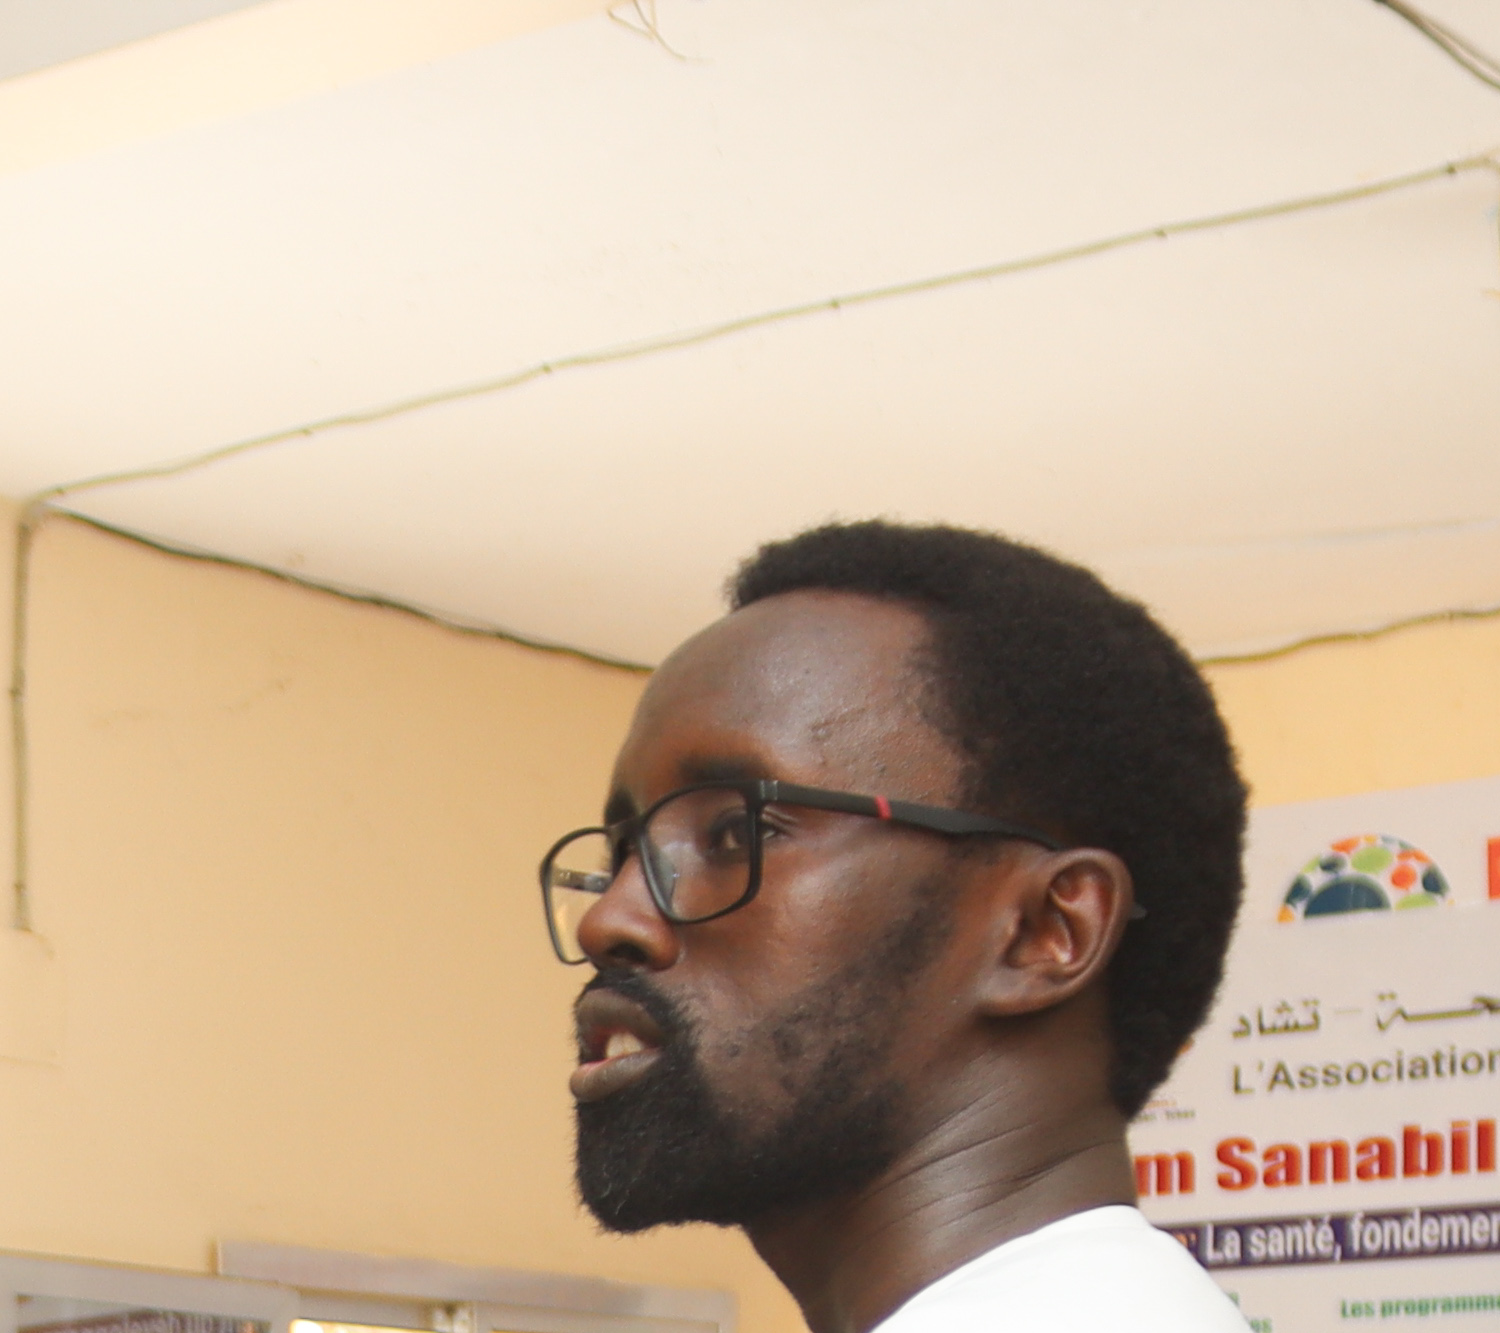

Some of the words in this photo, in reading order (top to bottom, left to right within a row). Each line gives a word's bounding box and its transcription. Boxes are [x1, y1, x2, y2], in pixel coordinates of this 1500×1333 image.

[1232, 1000, 1321, 1038] تشاد
[1214, 1116, 1498, 1192] Sanabil
[1205, 1223, 1243, 1263] La
[1249, 1213, 1342, 1263] santé,
[1339, 1299, 1375, 1319] Les
